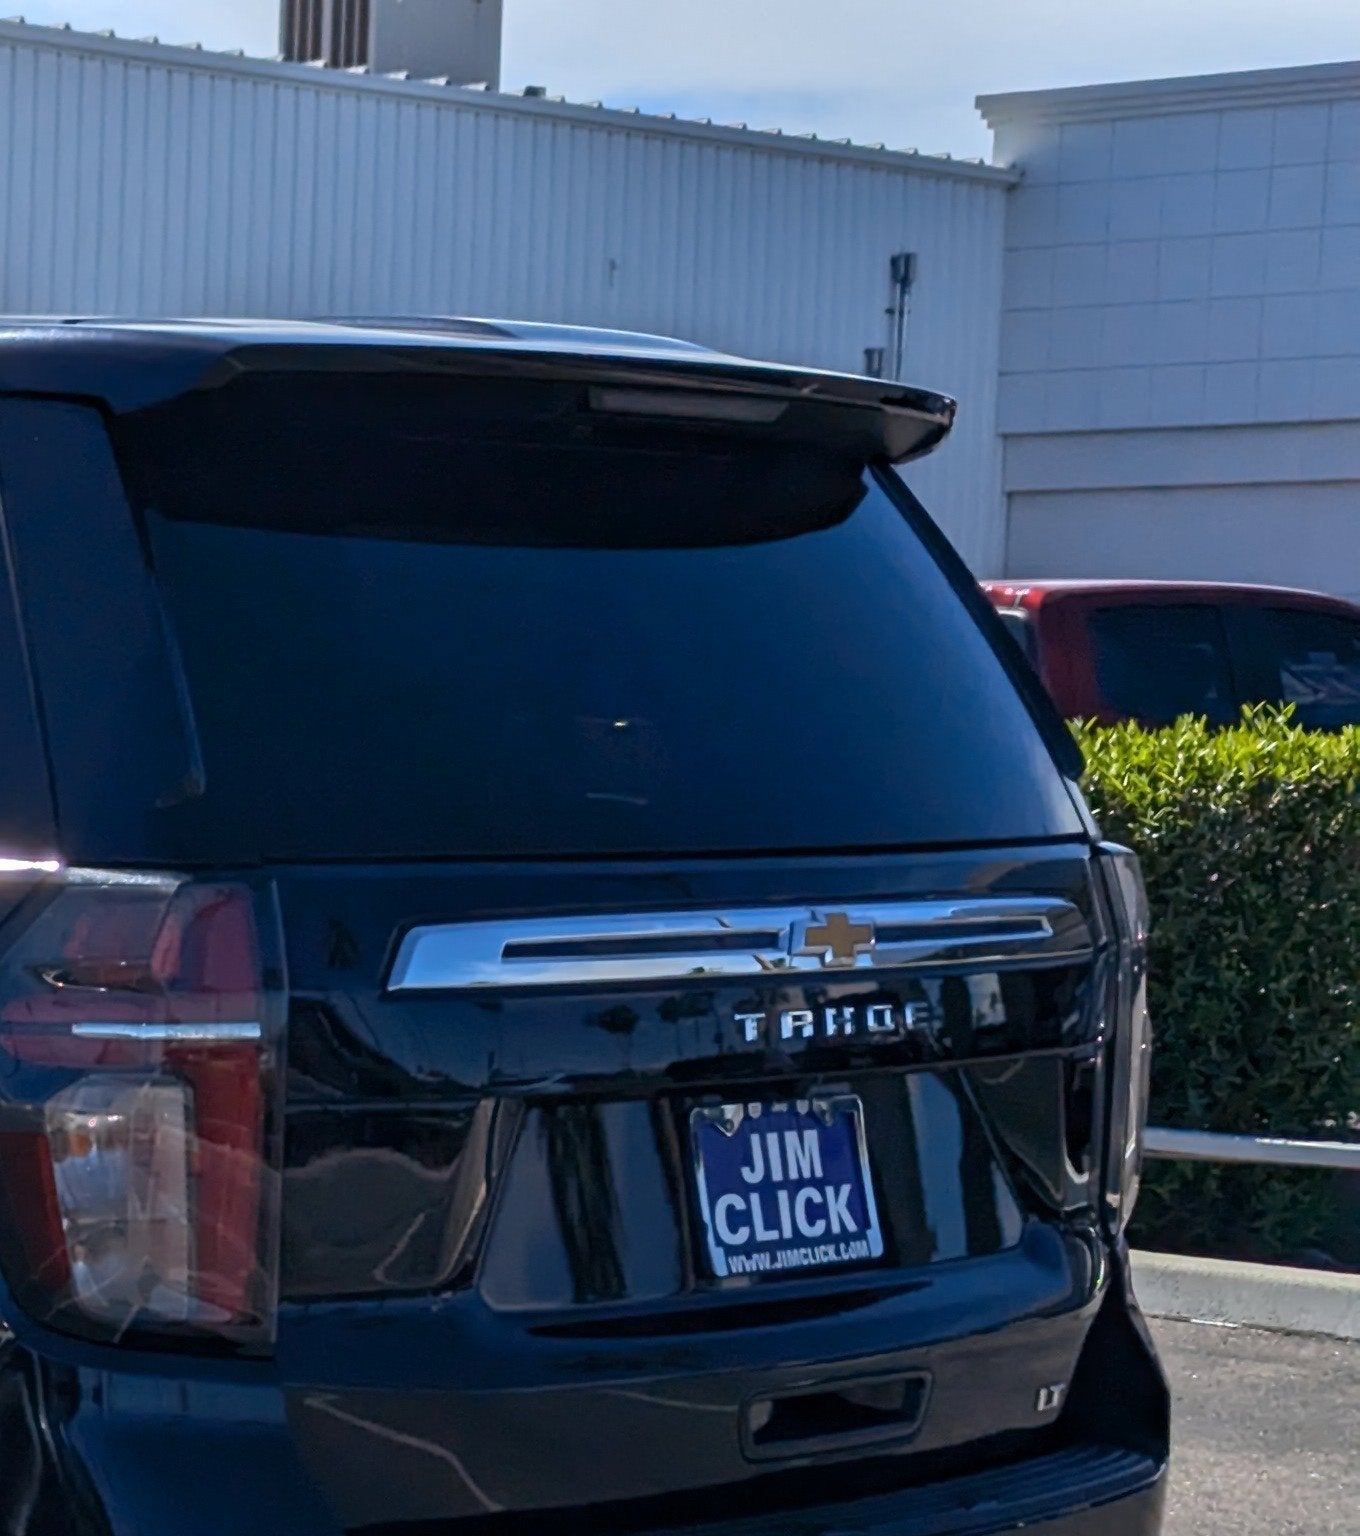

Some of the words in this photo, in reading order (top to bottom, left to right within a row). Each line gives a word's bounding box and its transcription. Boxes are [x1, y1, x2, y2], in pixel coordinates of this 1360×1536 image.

[733, 1001, 929, 1042] TAHOE
[740, 1128, 825, 1185] JIM
[713, 1183, 858, 1246] CLICK
[728, 1239, 870, 1274] WWW.JIMCLICK.COM
